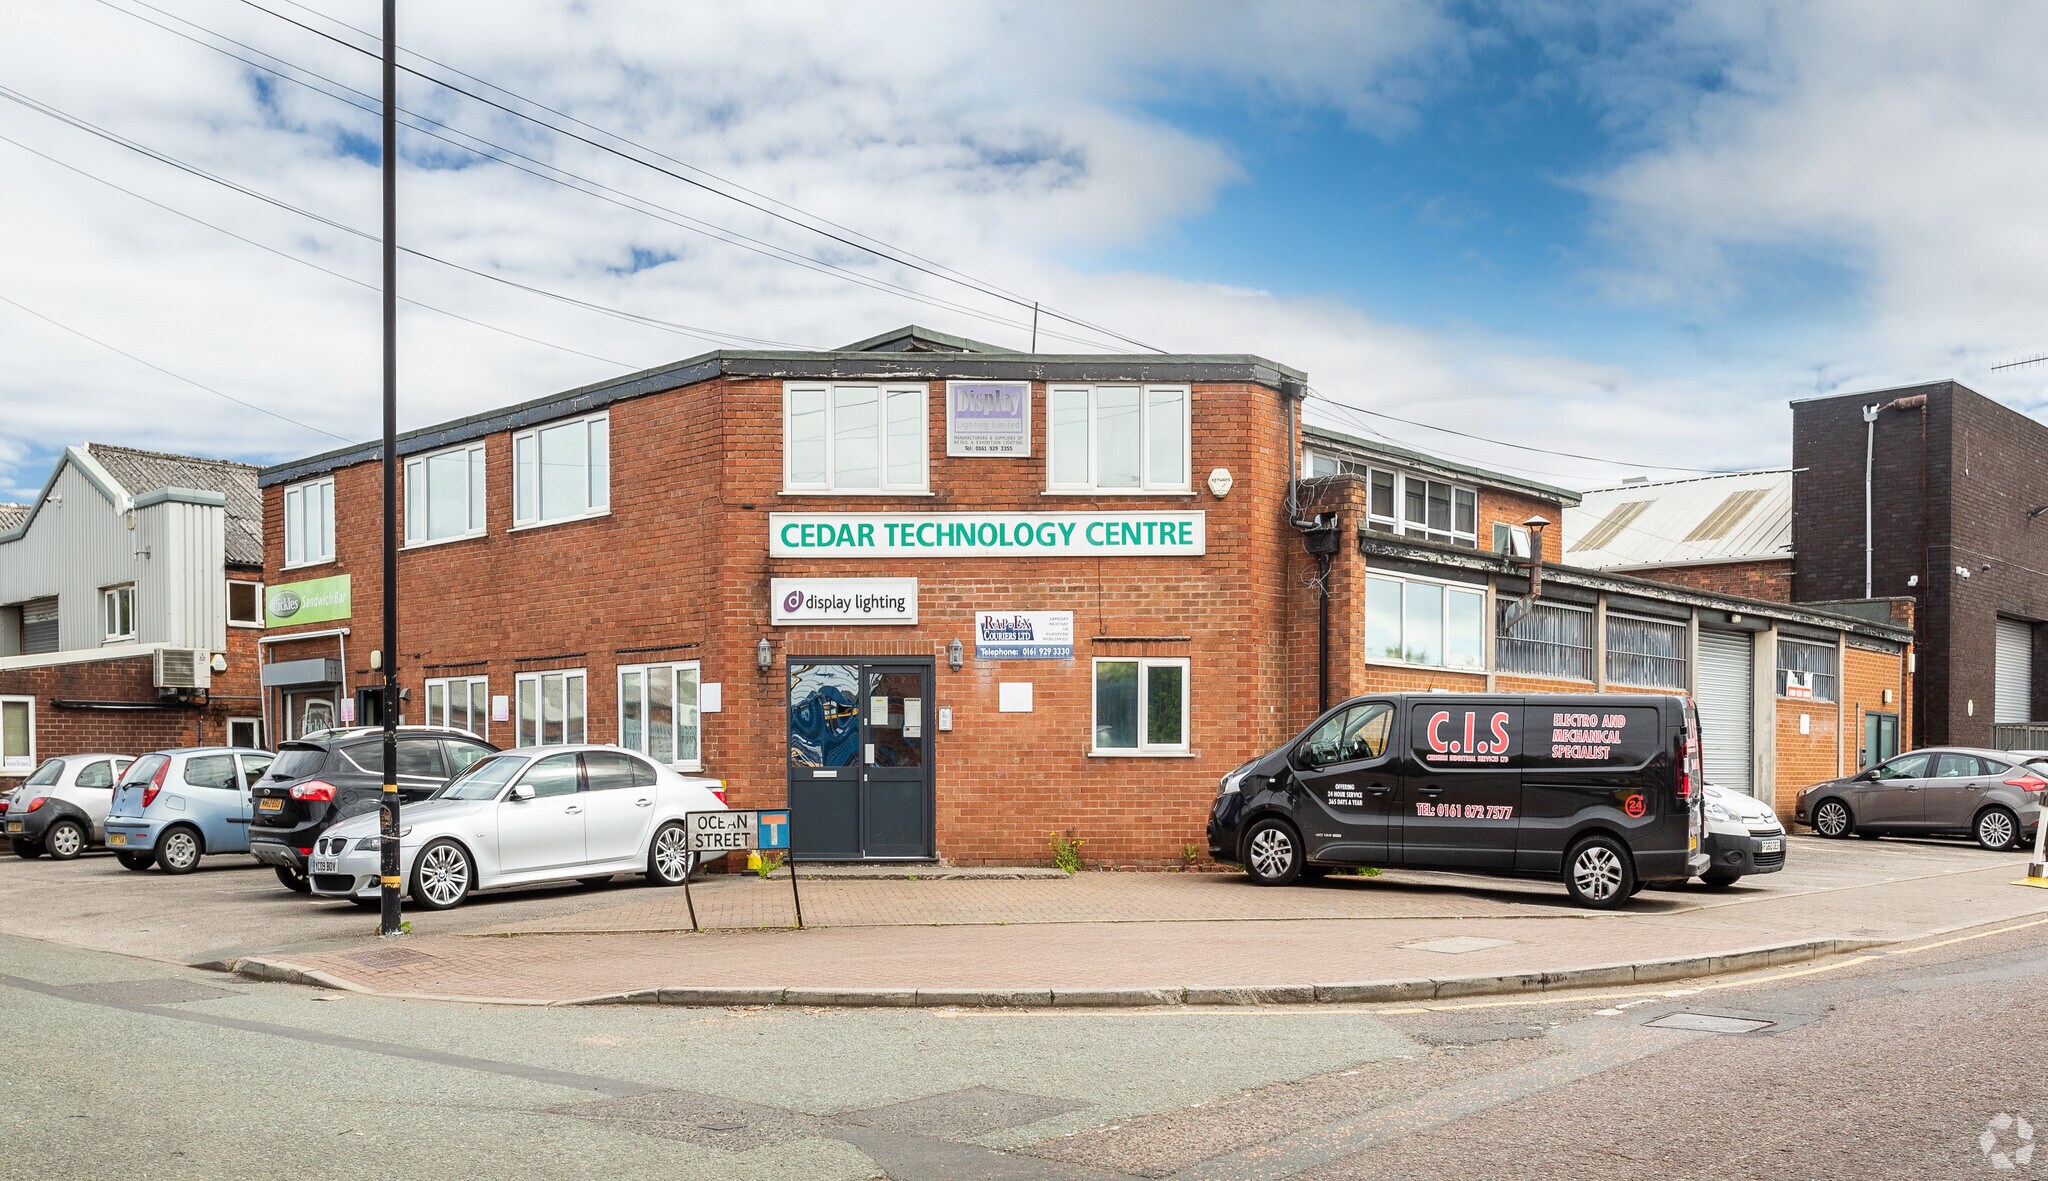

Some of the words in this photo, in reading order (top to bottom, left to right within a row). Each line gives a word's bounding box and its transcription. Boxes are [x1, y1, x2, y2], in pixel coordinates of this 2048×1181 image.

[957, 389, 1021, 416] Display
[957, 421, 988, 430] Lighting
[991, 421, 1020, 429] Limited
[780, 522, 875, 548] CEDAR
[884, 521, 1077, 547] TECHNOLOGY
[1085, 521, 1193, 546] CENTRE
[273, 597, 299, 612] Pickles
[302, 592, 333, 608] Sandwich
[334, 591, 346, 605] Bar
[806, 594, 851, 613] display
[855, 593, 906, 612] lighting
[1017, 631, 1031, 640] LTD
[980, 648, 1019, 657] Telephone:
[1022, 647, 1037, 656] 0161
[1039, 647, 1052, 655] 929
[1053, 647, 1070, 655] 3330
[1553, 713, 1598, 727] ELECTRO
[1601, 714, 1626, 728] AND
[1427, 711, 1510, 754] C.I.S
[1552, 729, 1621, 744] MECHANICAL
[1552, 745, 1610, 759] SPECIALIST
[1416, 802, 1435, 816] TEL:
[1436, 803, 1461, 817] 0161
[1464, 804, 1485, 818] 872
[1486, 805, 1513, 820] 7577
[1629, 800, 1643, 809] 24
[697, 814, 748, 830] OCEAN
[695, 832, 751, 848] STREET
